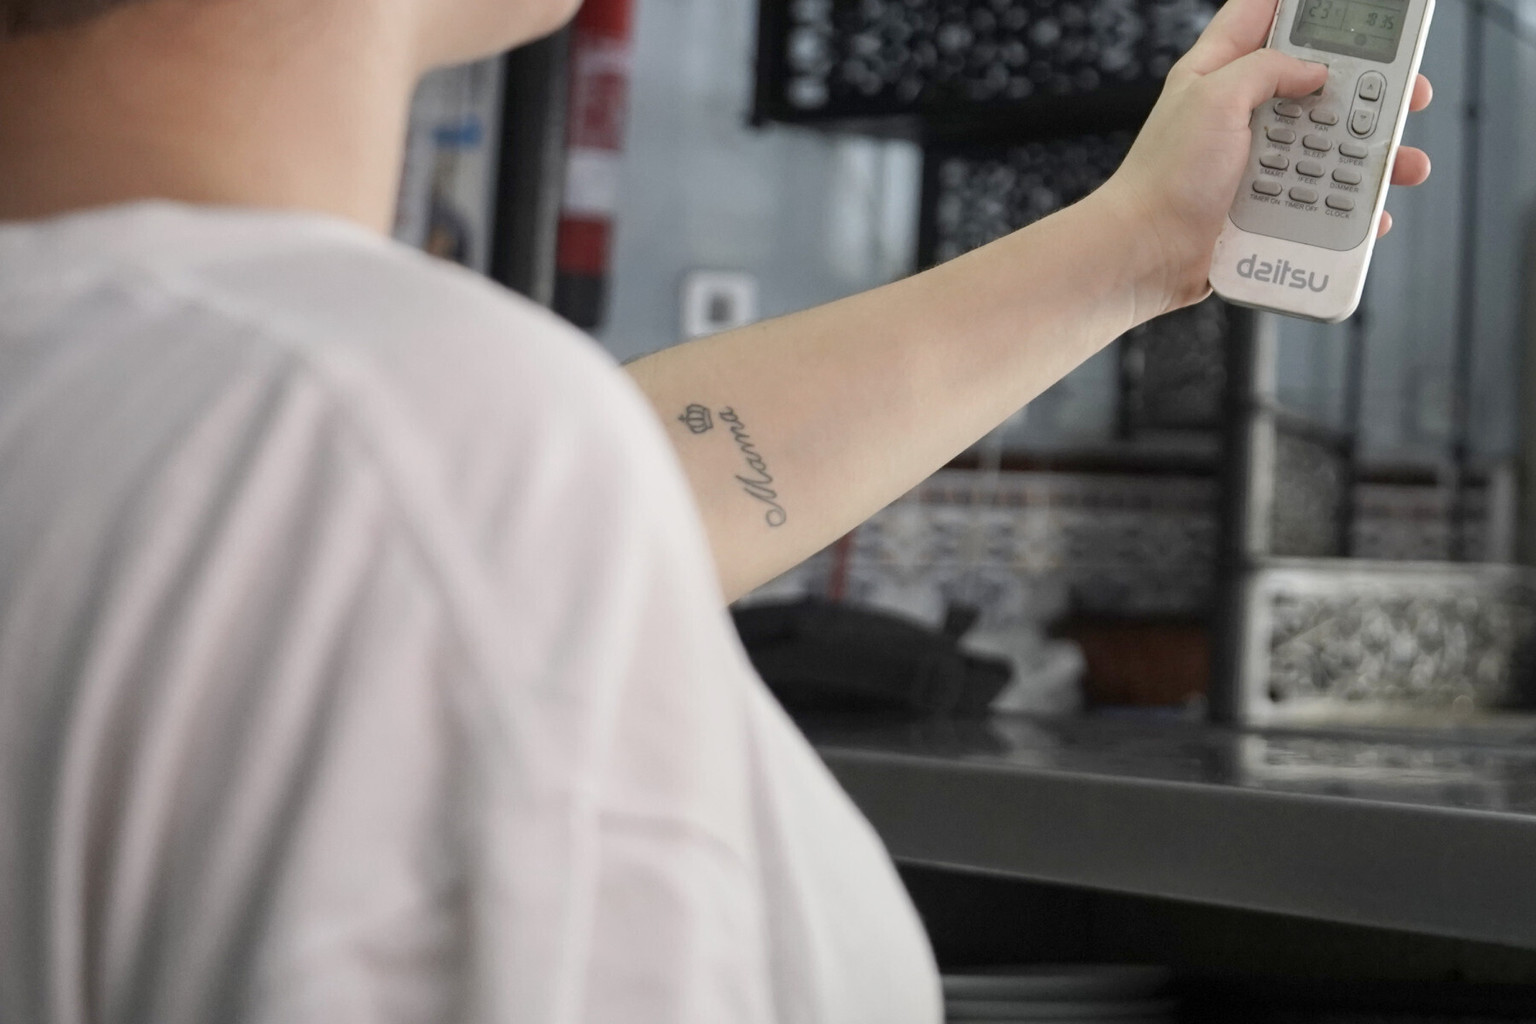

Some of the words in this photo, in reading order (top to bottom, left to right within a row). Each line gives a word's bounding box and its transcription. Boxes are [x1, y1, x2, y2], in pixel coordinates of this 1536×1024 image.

[1314, 124, 1329, 132] FAN
[1303, 149, 1327, 158] SLEEP
[1339, 157, 1364, 167] SUPER
[1260, 169, 1285, 178] SMART
[1329, 183, 1359, 193] DIMMER
[1250, 193, 1269, 203] TIMER
[1270, 198, 1281, 206] ON
[1285, 201, 1304, 210] TIMER
[1305, 204, 1319, 212] OFF
[1325, 209, 1350, 219] CLOCK
